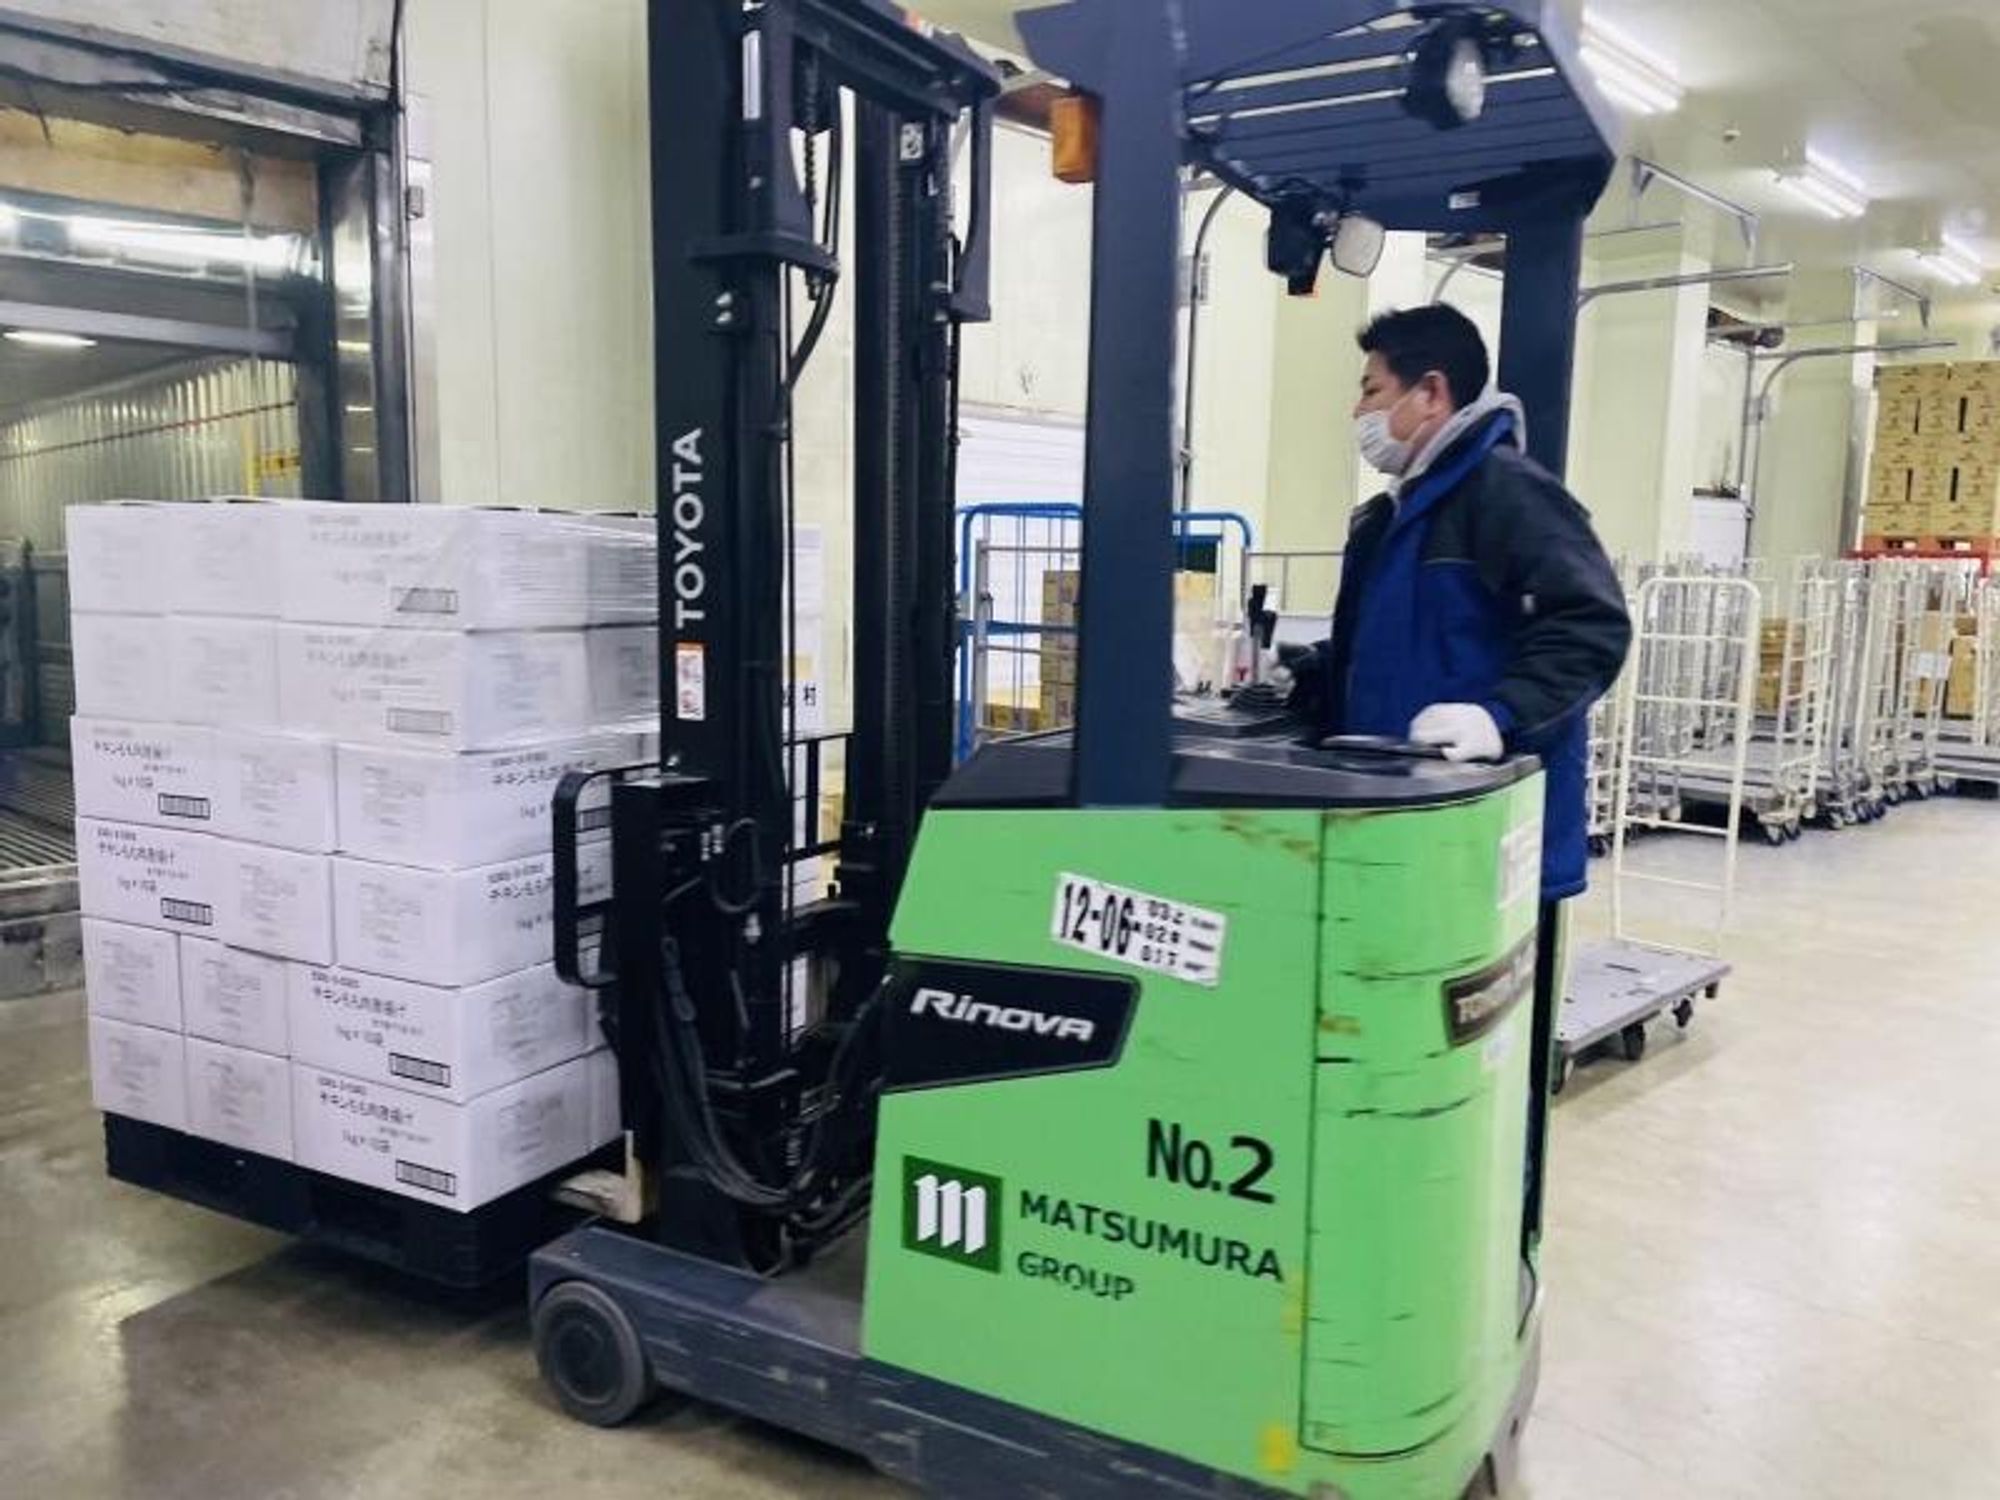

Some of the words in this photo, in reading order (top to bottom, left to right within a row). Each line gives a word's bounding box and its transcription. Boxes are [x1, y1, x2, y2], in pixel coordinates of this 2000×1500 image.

[673, 427, 704, 629] TOYOTA
[1146, 1117, 1275, 1204] No.2
[1016, 1250, 1134, 1301] GROUP
[1019, 1189, 1284, 1283] MATSUMURA
